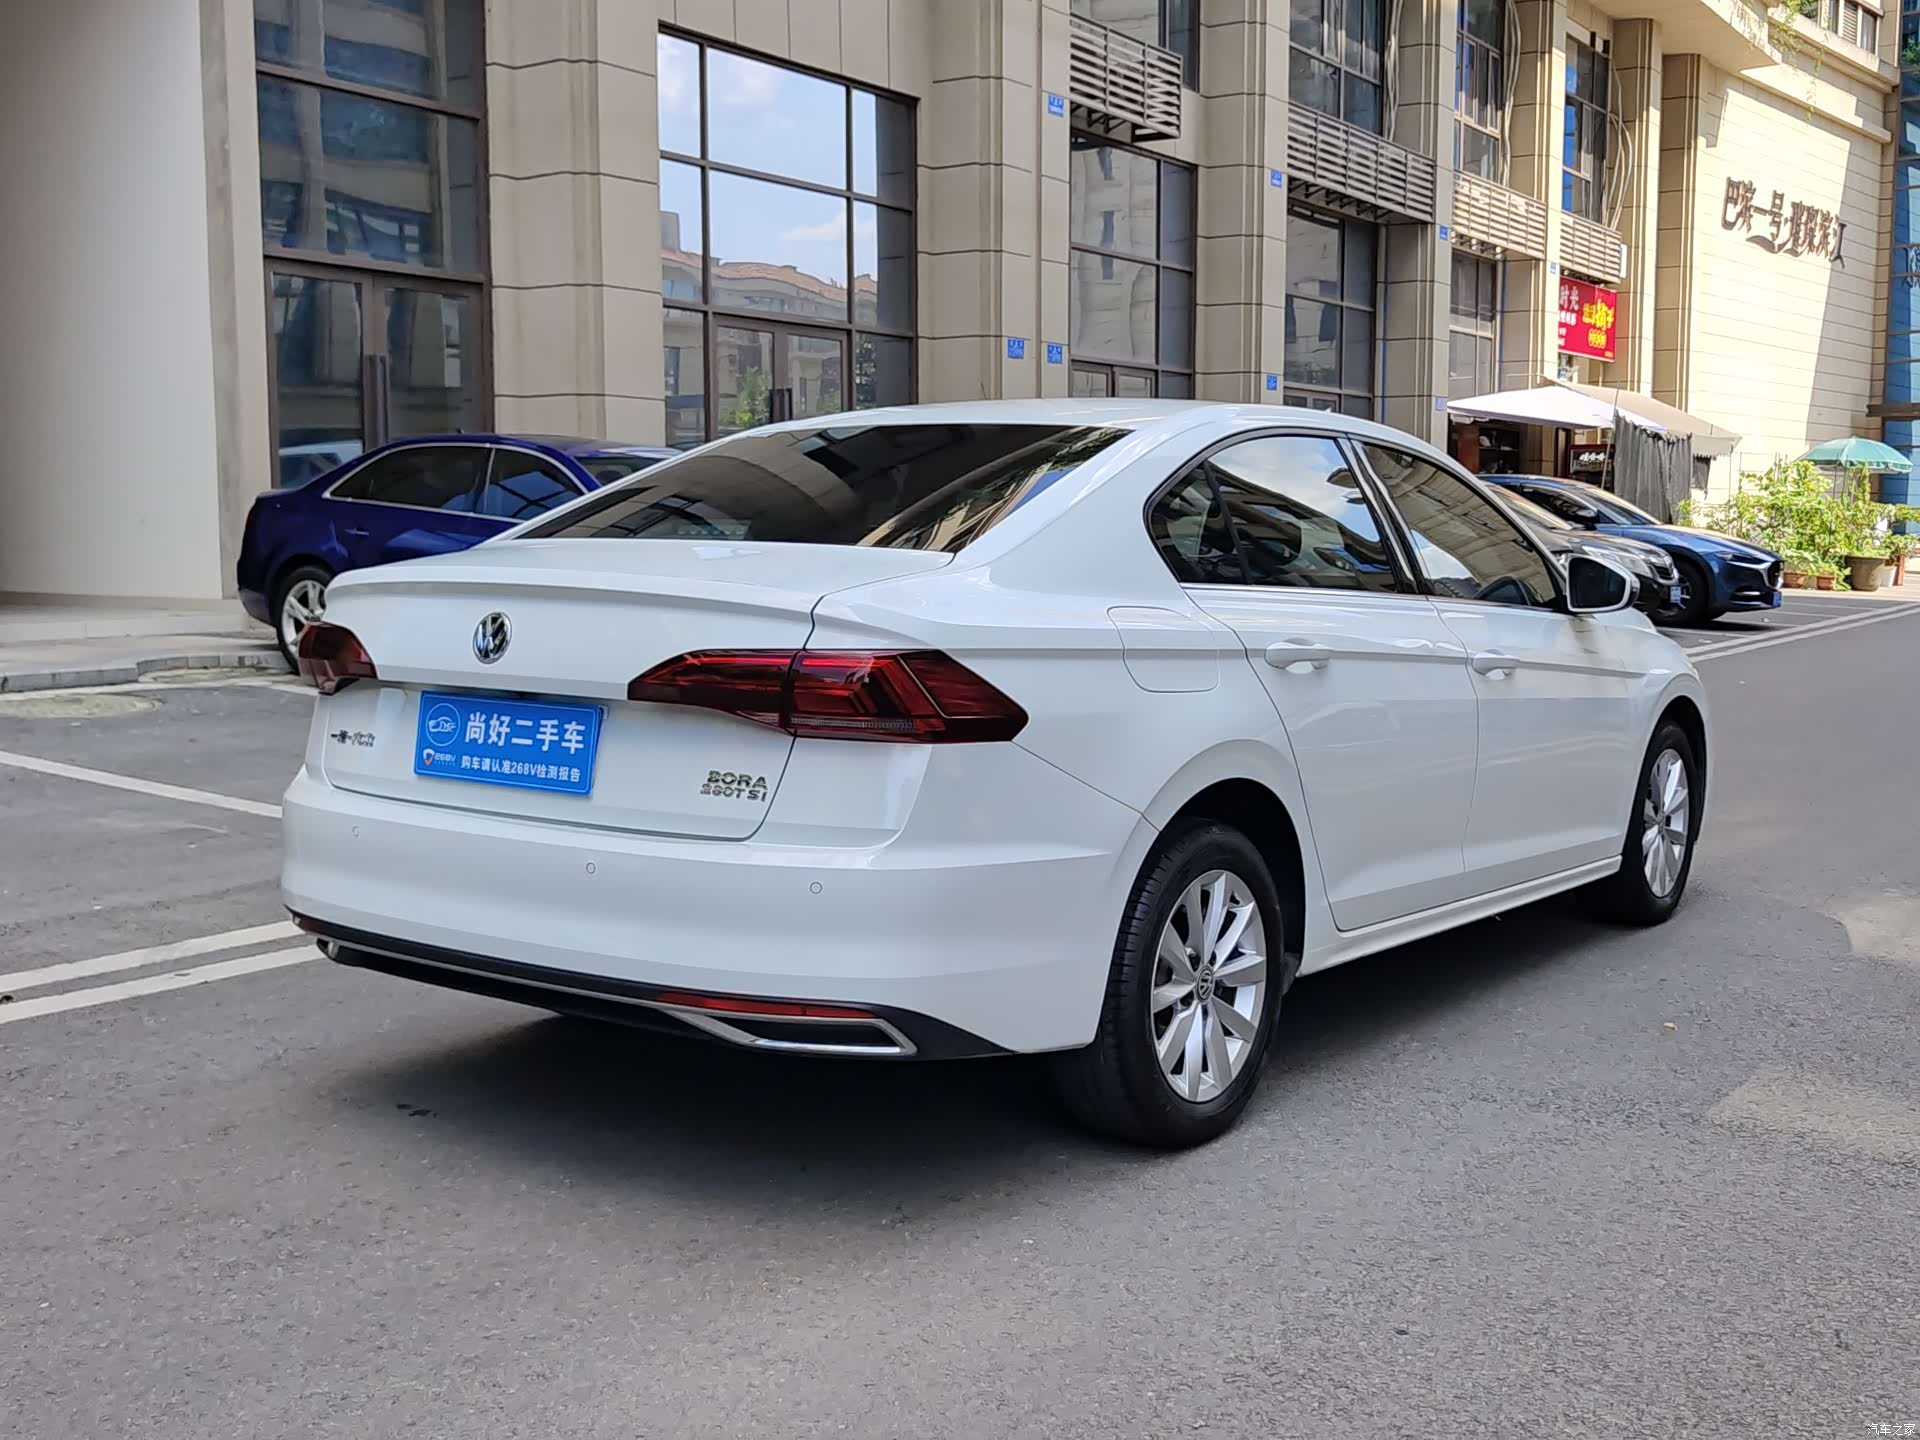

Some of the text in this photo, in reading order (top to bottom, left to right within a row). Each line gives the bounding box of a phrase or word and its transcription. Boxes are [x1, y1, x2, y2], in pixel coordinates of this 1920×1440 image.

[465, 711, 586, 755] 尚好二手车
[461, 754, 581, 783] 购车请认准268V检测报告
[707, 769, 768, 791] BORA
